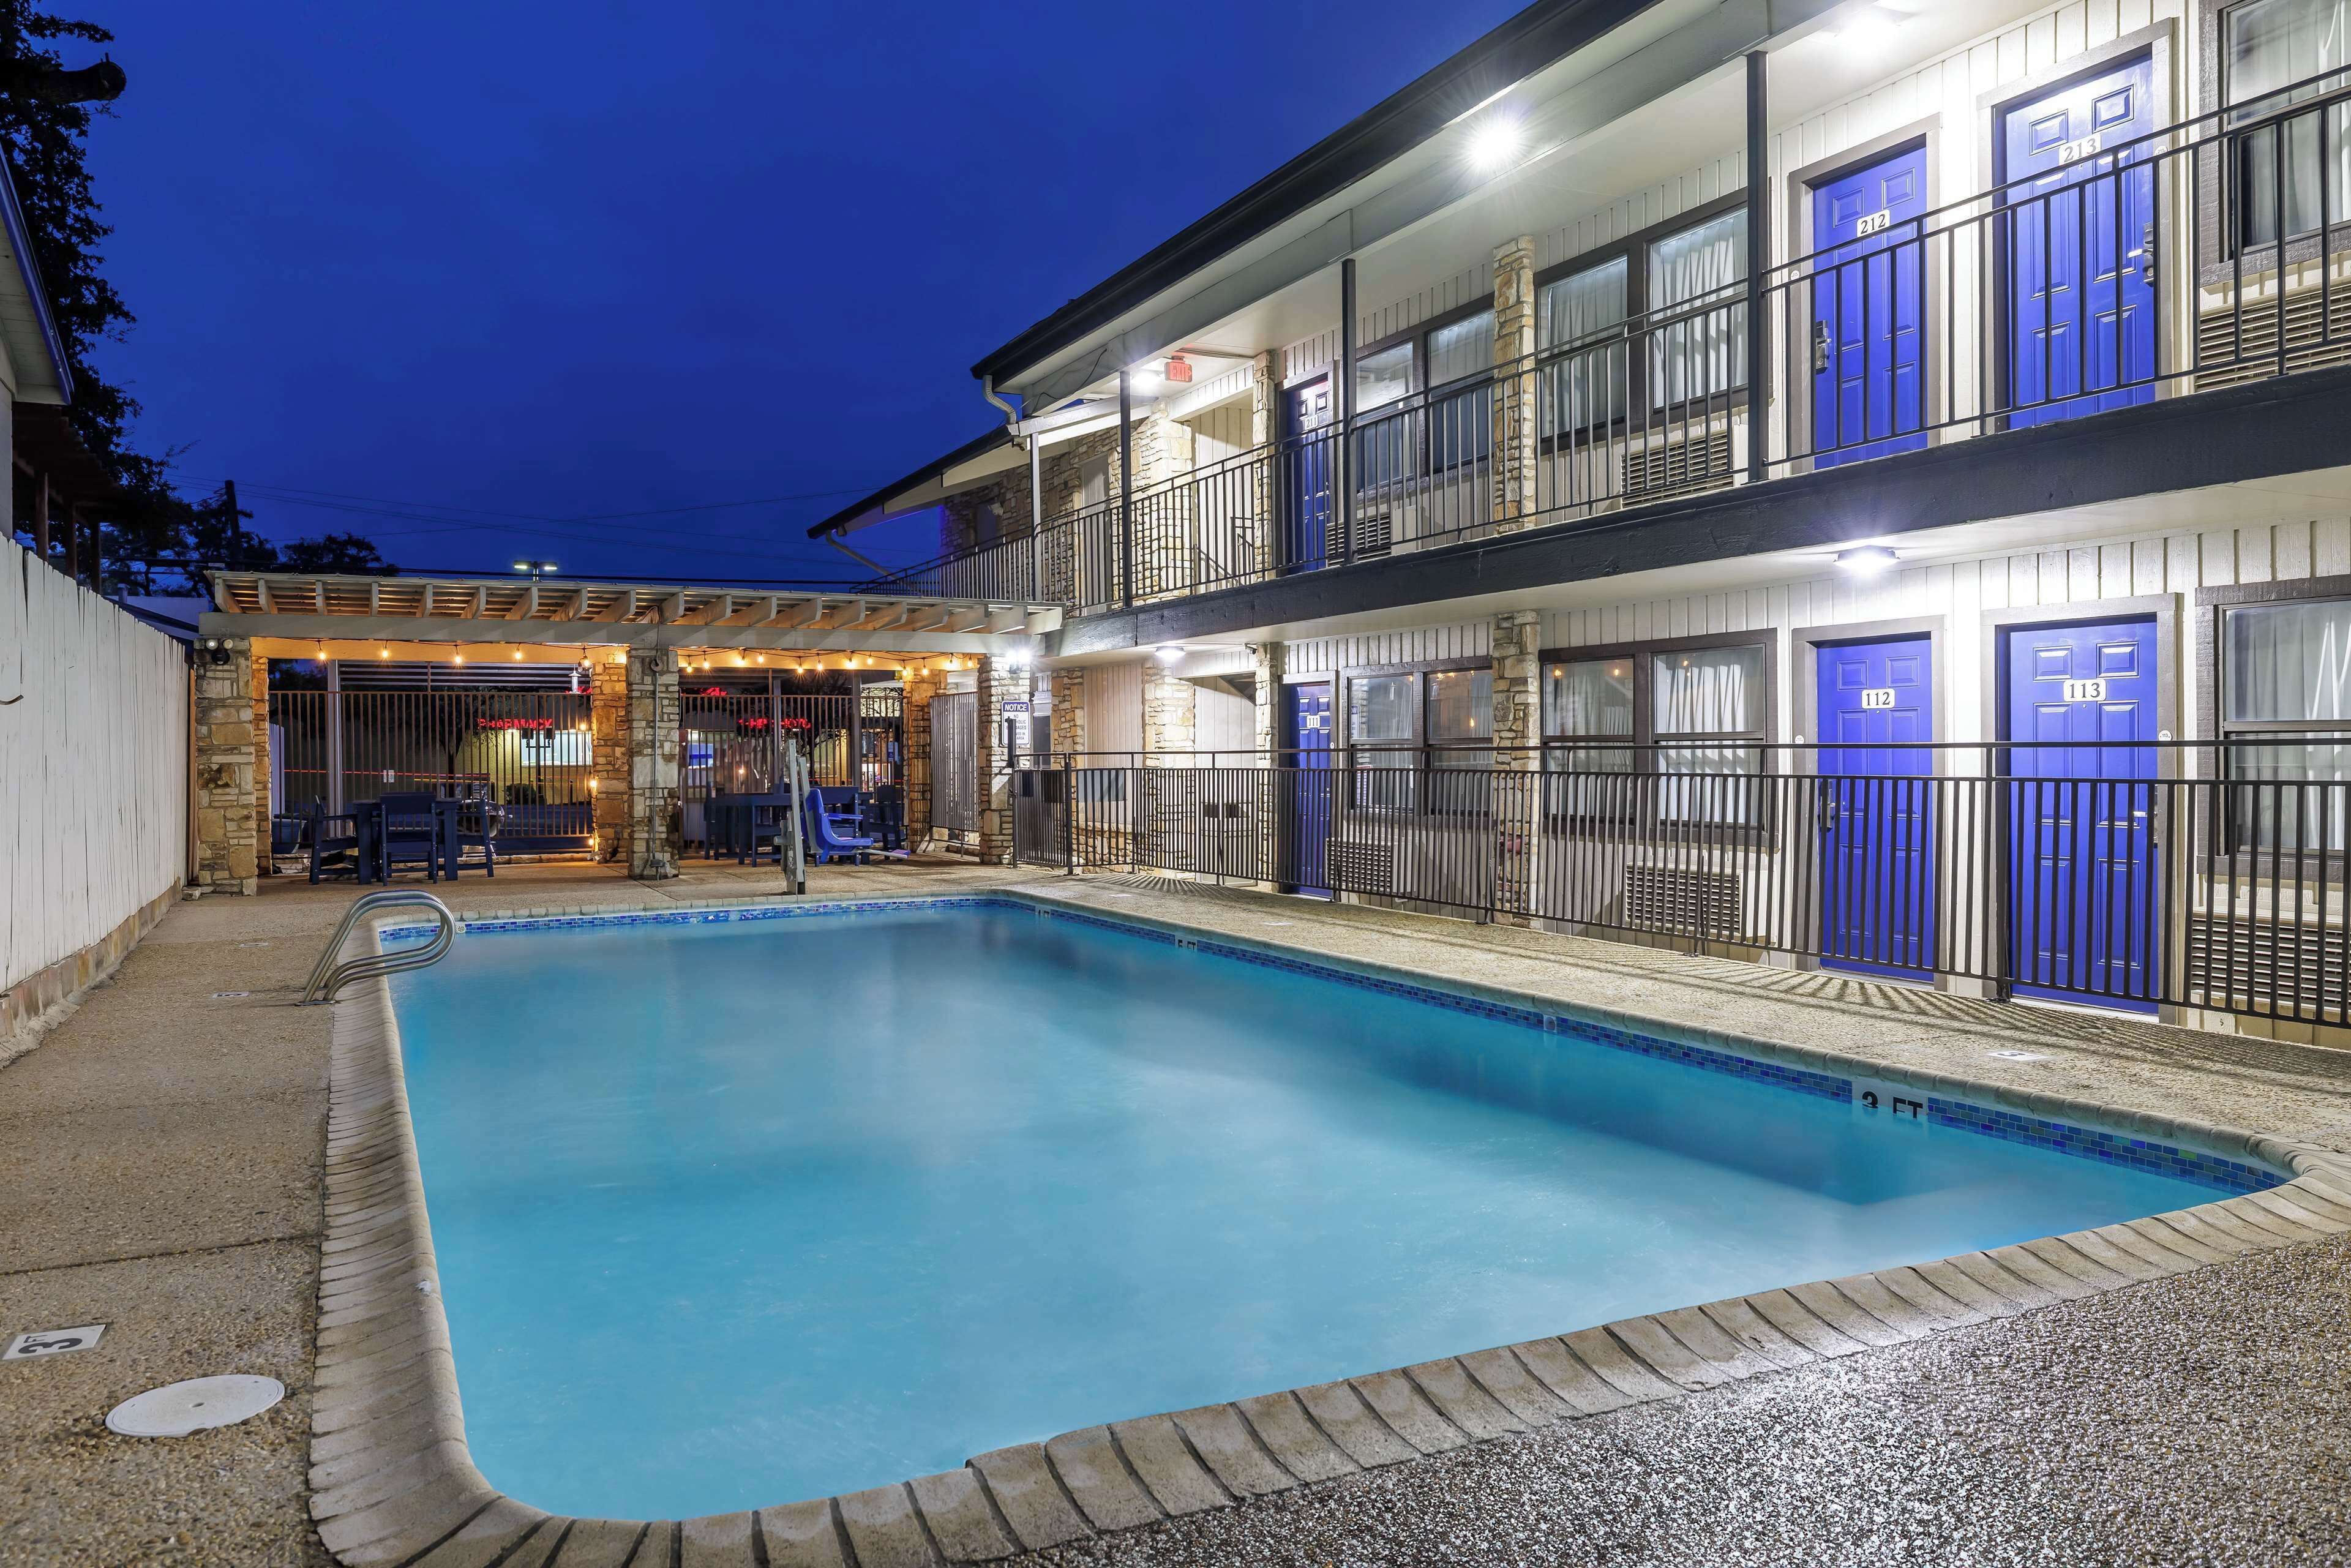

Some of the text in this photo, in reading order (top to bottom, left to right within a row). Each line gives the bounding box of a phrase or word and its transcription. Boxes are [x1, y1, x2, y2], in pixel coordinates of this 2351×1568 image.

[2064, 138, 2096, 162] 213
[1861, 214, 1886, 234] 212
[1170, 363, 1189, 381] EXIT
[1306, 418, 1316, 428] 211
[1866, 691, 1891, 706] 112
[2069, 683, 2100, 699] 113
[477, 718, 553, 730] PHARMACY
[1309, 718, 1318, 726] 111
[1892, 1097, 1923, 1119] FT
[18, 1338, 83, 1354] 3
